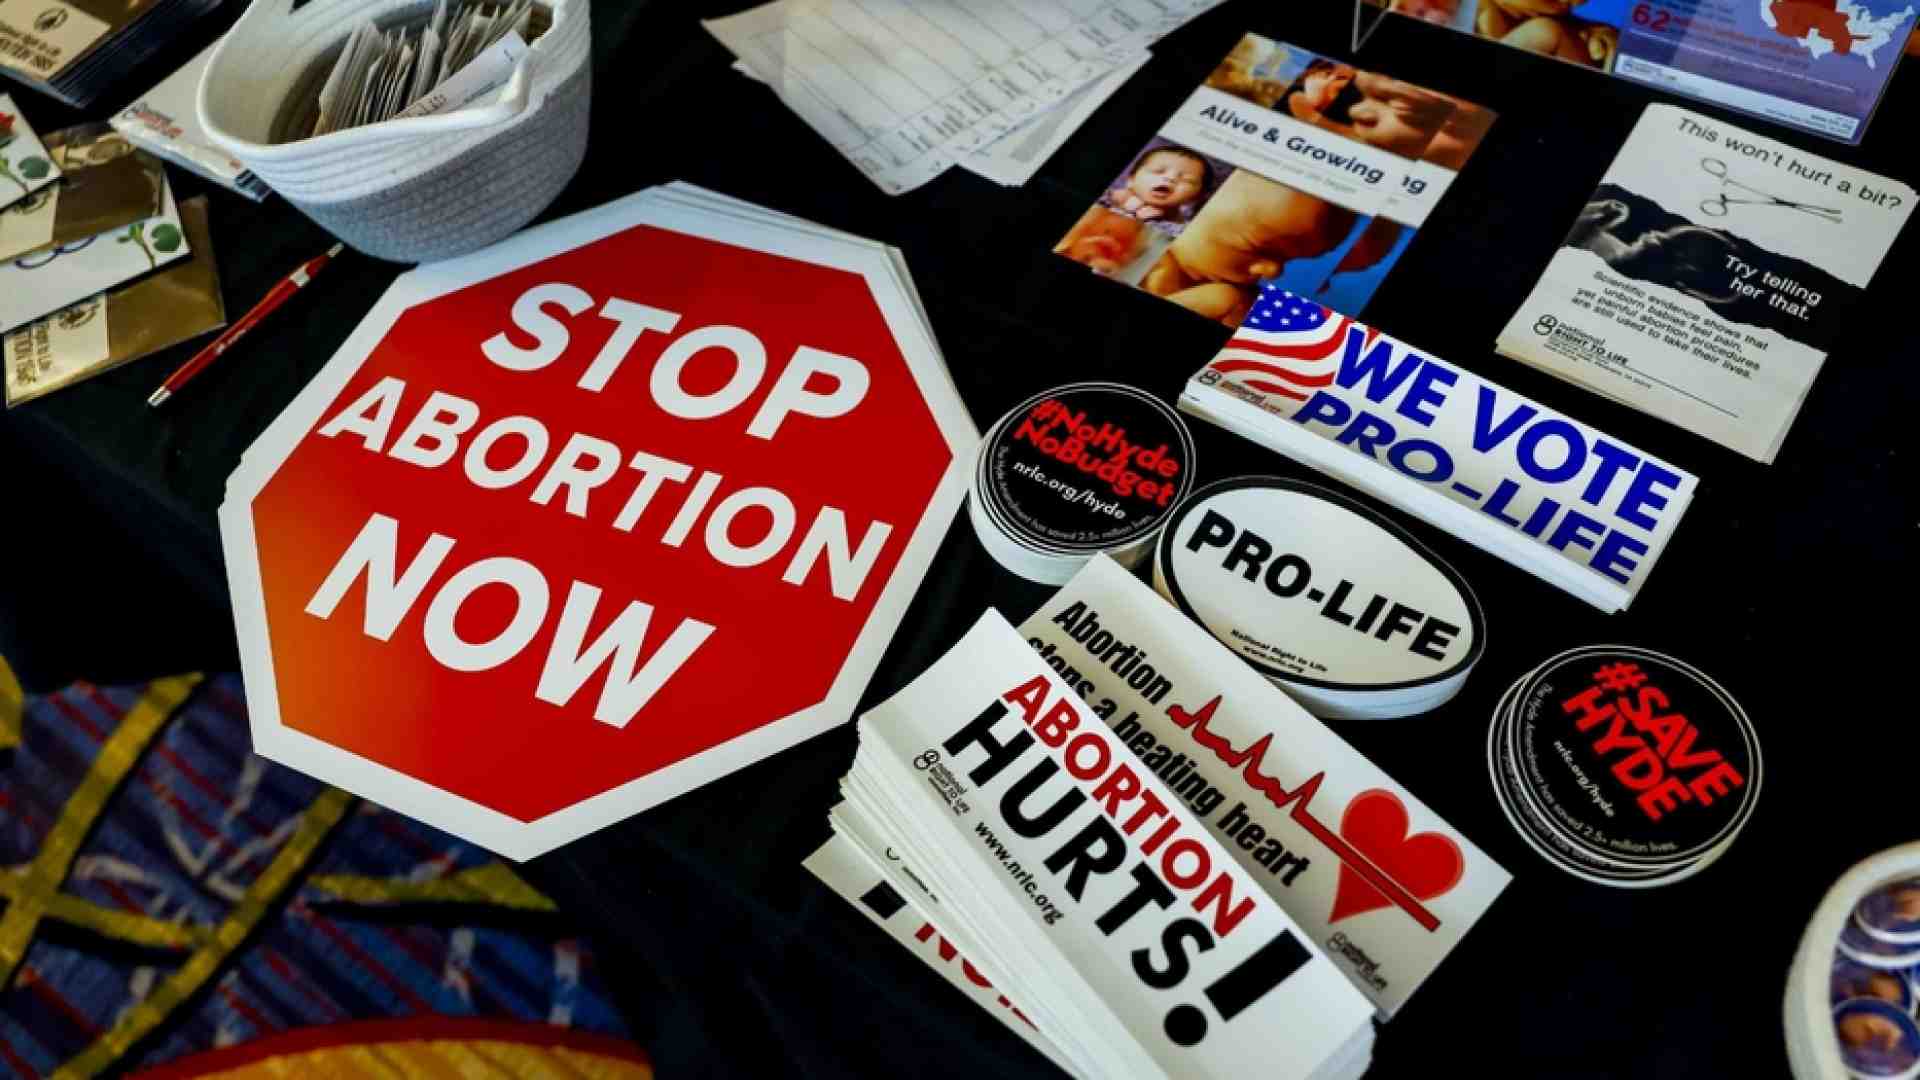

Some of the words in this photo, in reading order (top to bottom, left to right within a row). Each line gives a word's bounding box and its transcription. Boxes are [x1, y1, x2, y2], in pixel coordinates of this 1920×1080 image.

[1632, 3, 1671, 31] 62
[1200, 104, 1258, 135] Alive
[1263, 128, 1281, 144] &
[1286, 136, 1385, 184] Growing
[1678, 117, 1719, 143] This
[1725, 136, 1784, 167] won't
[1787, 160, 1832, 186] hurt
[1837, 180, 1851, 194] a
[1859, 185, 1902, 211] bit?
[1616, 314, 1646, 333] used
[1647, 327, 1661, 340] to
[1647, 295, 1700, 321] evidence
[1703, 318, 1741, 340] shows
[1744, 333, 1768, 351] that
[1725, 254, 1757, 279] Try
[1762, 271, 1822, 307] telling
[1729, 277, 1765, 299] her
[1768, 293, 1810, 321] that.
[480, 282, 871, 441] STOP
[1639, 314, 1689, 339] abortion
[1690, 334, 1760, 371] procedures
[1013, 417, 1175, 506] NoBudget
[1030, 399, 1180, 477] #NoHyde
[1332, 326, 1459, 428] WE
[1471, 396, 1683, 533] VOTE
[317, 375, 894, 602] ABORTION
[1013, 462, 1126, 520] nrlc.org/hyde
[1291, 390, 1650, 586] PRO-LIFE
[304, 512, 718, 730] NOW
[1185, 509, 1461, 661] PRO-LIFE
[1052, 600, 1173, 705] Abortion
[1554, 740, 1615, 817] nrlc.org/hyde
[1561, 686, 1693, 822] HYDE
[1593, 662, 1745, 806] #SAVE
[1003, 674, 1257, 939] ABORTION
[1092, 698, 1117, 721] a
[1216, 801, 1310, 887] heart
[941, 699, 1315, 1049] HURTS!
[975, 822, 1065, 925] www.nrlc.org
